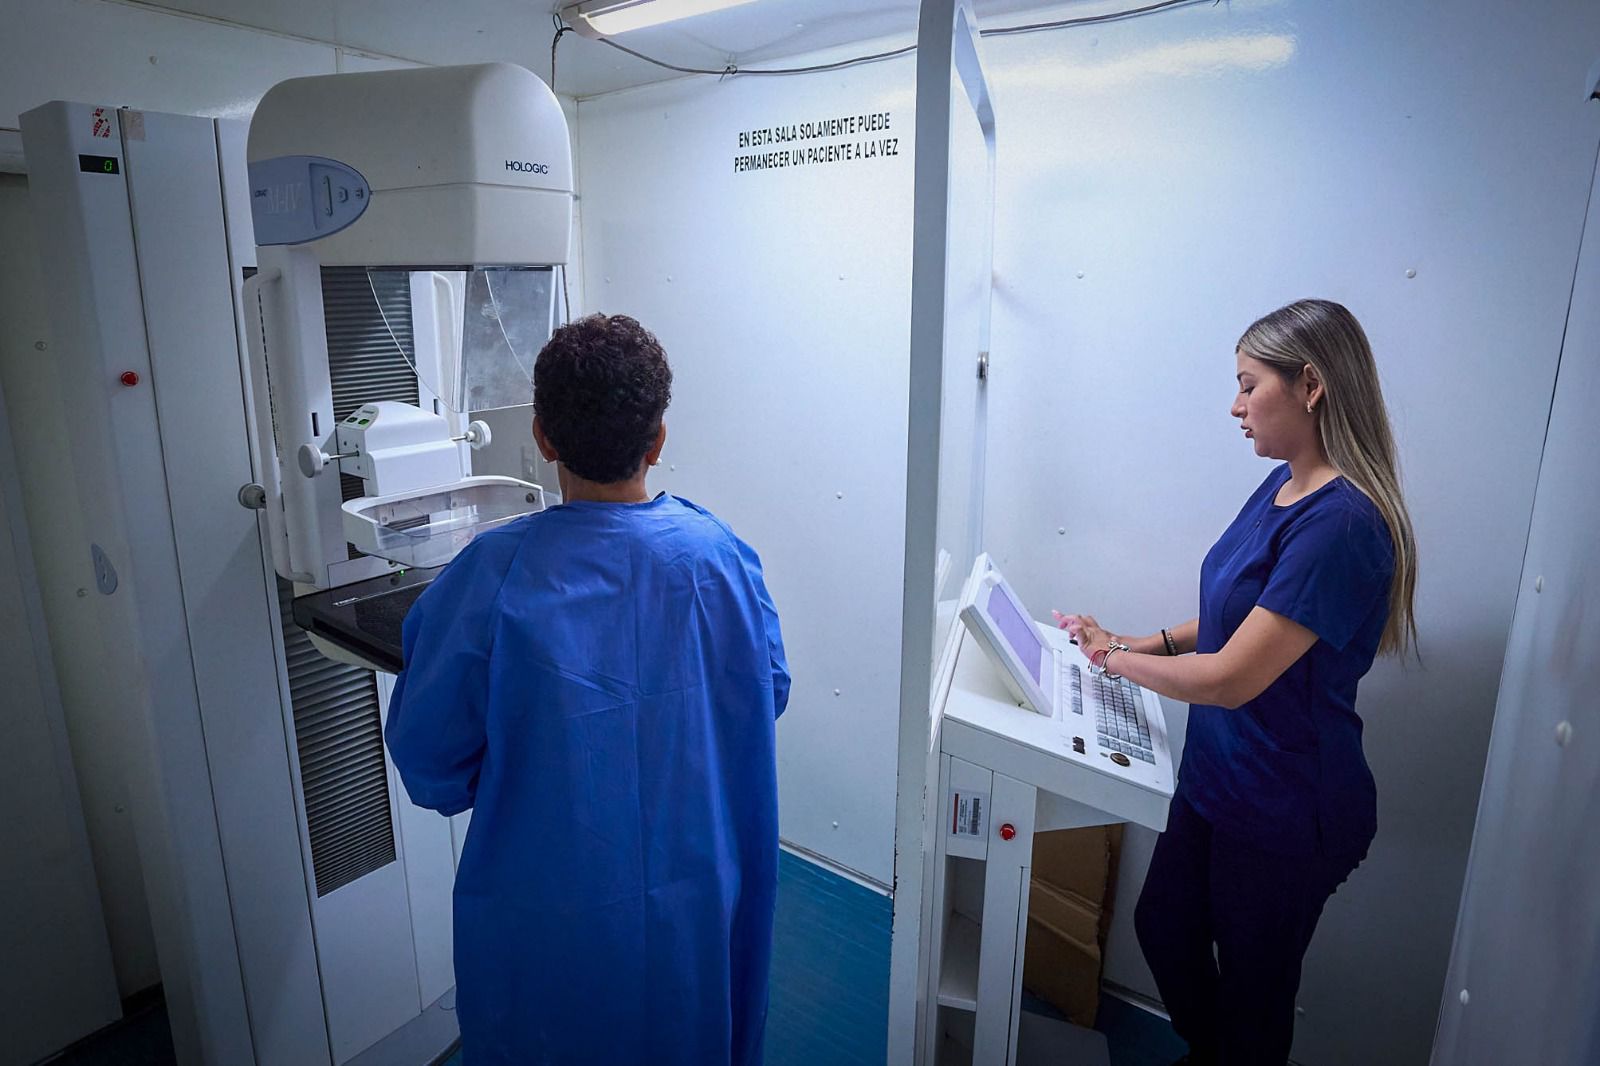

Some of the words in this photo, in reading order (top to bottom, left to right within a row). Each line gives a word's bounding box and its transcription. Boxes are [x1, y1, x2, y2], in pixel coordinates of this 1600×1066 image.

[739, 132, 749, 148] EN
[752, 128, 773, 146] ESTA
[775, 124, 797, 143] SALA
[800, 116, 855, 140] SOLAMENTE
[858, 112, 890, 132] PUEDE
[505, 159, 548, 175] HOLOGIC
[734, 150, 790, 173] PERMANECER
[792, 149, 805, 166] UN
[807, 143, 852, 164] PACIENTE
[854, 142, 861, 159] A
[864, 141, 876, 158] LA
[879, 138, 898, 157] VEZ
